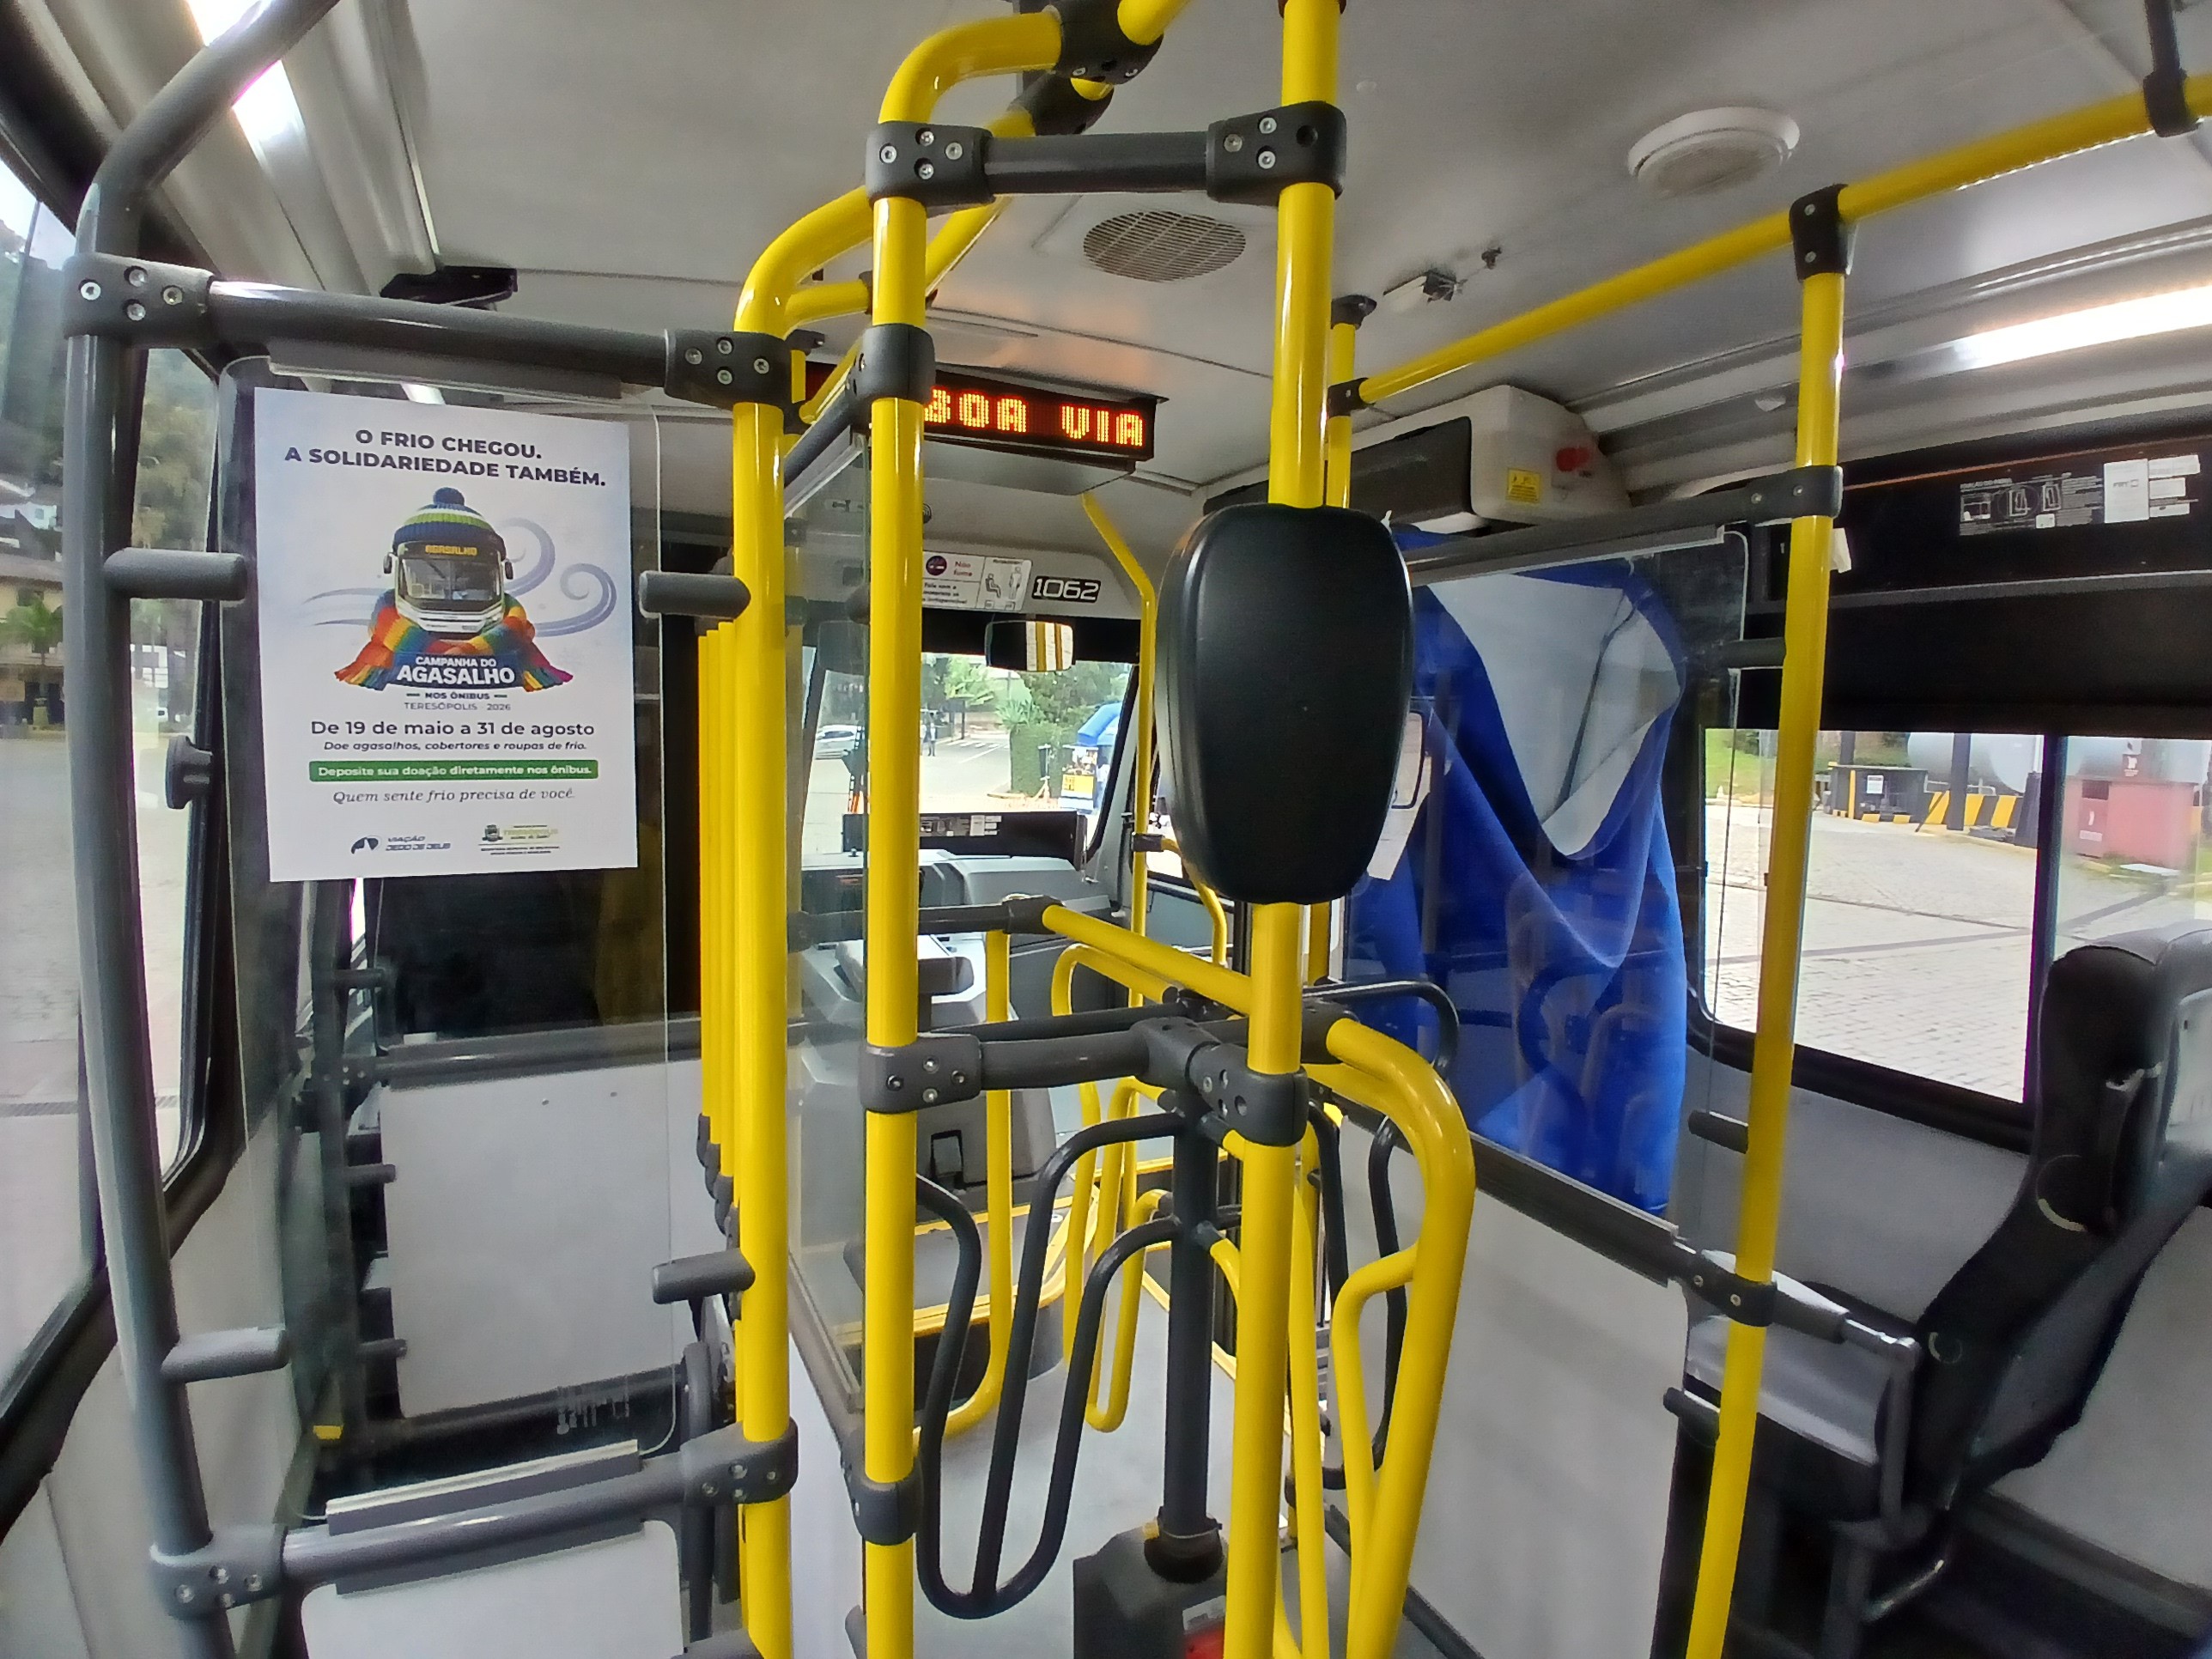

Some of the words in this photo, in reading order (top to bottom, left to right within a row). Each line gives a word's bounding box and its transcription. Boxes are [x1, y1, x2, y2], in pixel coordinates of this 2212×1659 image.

[1061, 405, 1143, 447] VIA
[355, 429, 374, 444] O
[380, 431, 434, 449] FRIO
[441, 437, 542, 459] CHEGOU.
[284, 447, 301, 461] A
[308, 448, 500, 477] SOLIDARIEDADE
[505, 465, 606, 486] TAMBÉM.
[1034, 578, 1099, 601] 1062
[416, 656, 478, 667] CAMPANHA
[481, 658, 497, 667] DO
[397, 665, 515, 685] AGASALHO
[450, 690, 490, 700] ÔNIBUS
[404, 702, 477, 711] TERESÓPOLIS
[311, 721, 339, 734] De
[345, 721, 366, 734] 19
[373, 721, 398, 734] de
[404, 720, 454, 735] maio
[460, 725, 471, 735] a
[477, 722, 495, 735] 31
[501, 722, 525, 735] de
[531, 724, 594, 738] agosto
[324, 741, 349, 750] Doe
[353, 742, 421, 751] agasalhos,
[503, 743, 544, 751] roupas
[564, 741, 586, 750] frio.
[318, 767, 374, 776] Deposite
[402, 766, 447, 776] doação
[449, 766, 524, 775] diretamente
[333, 792, 378, 805] Quem
[384, 790, 423, 802] sente
[426, 790, 455, 803] frio
[459, 788, 514, 803] precisa
[519, 788, 537, 799] de
